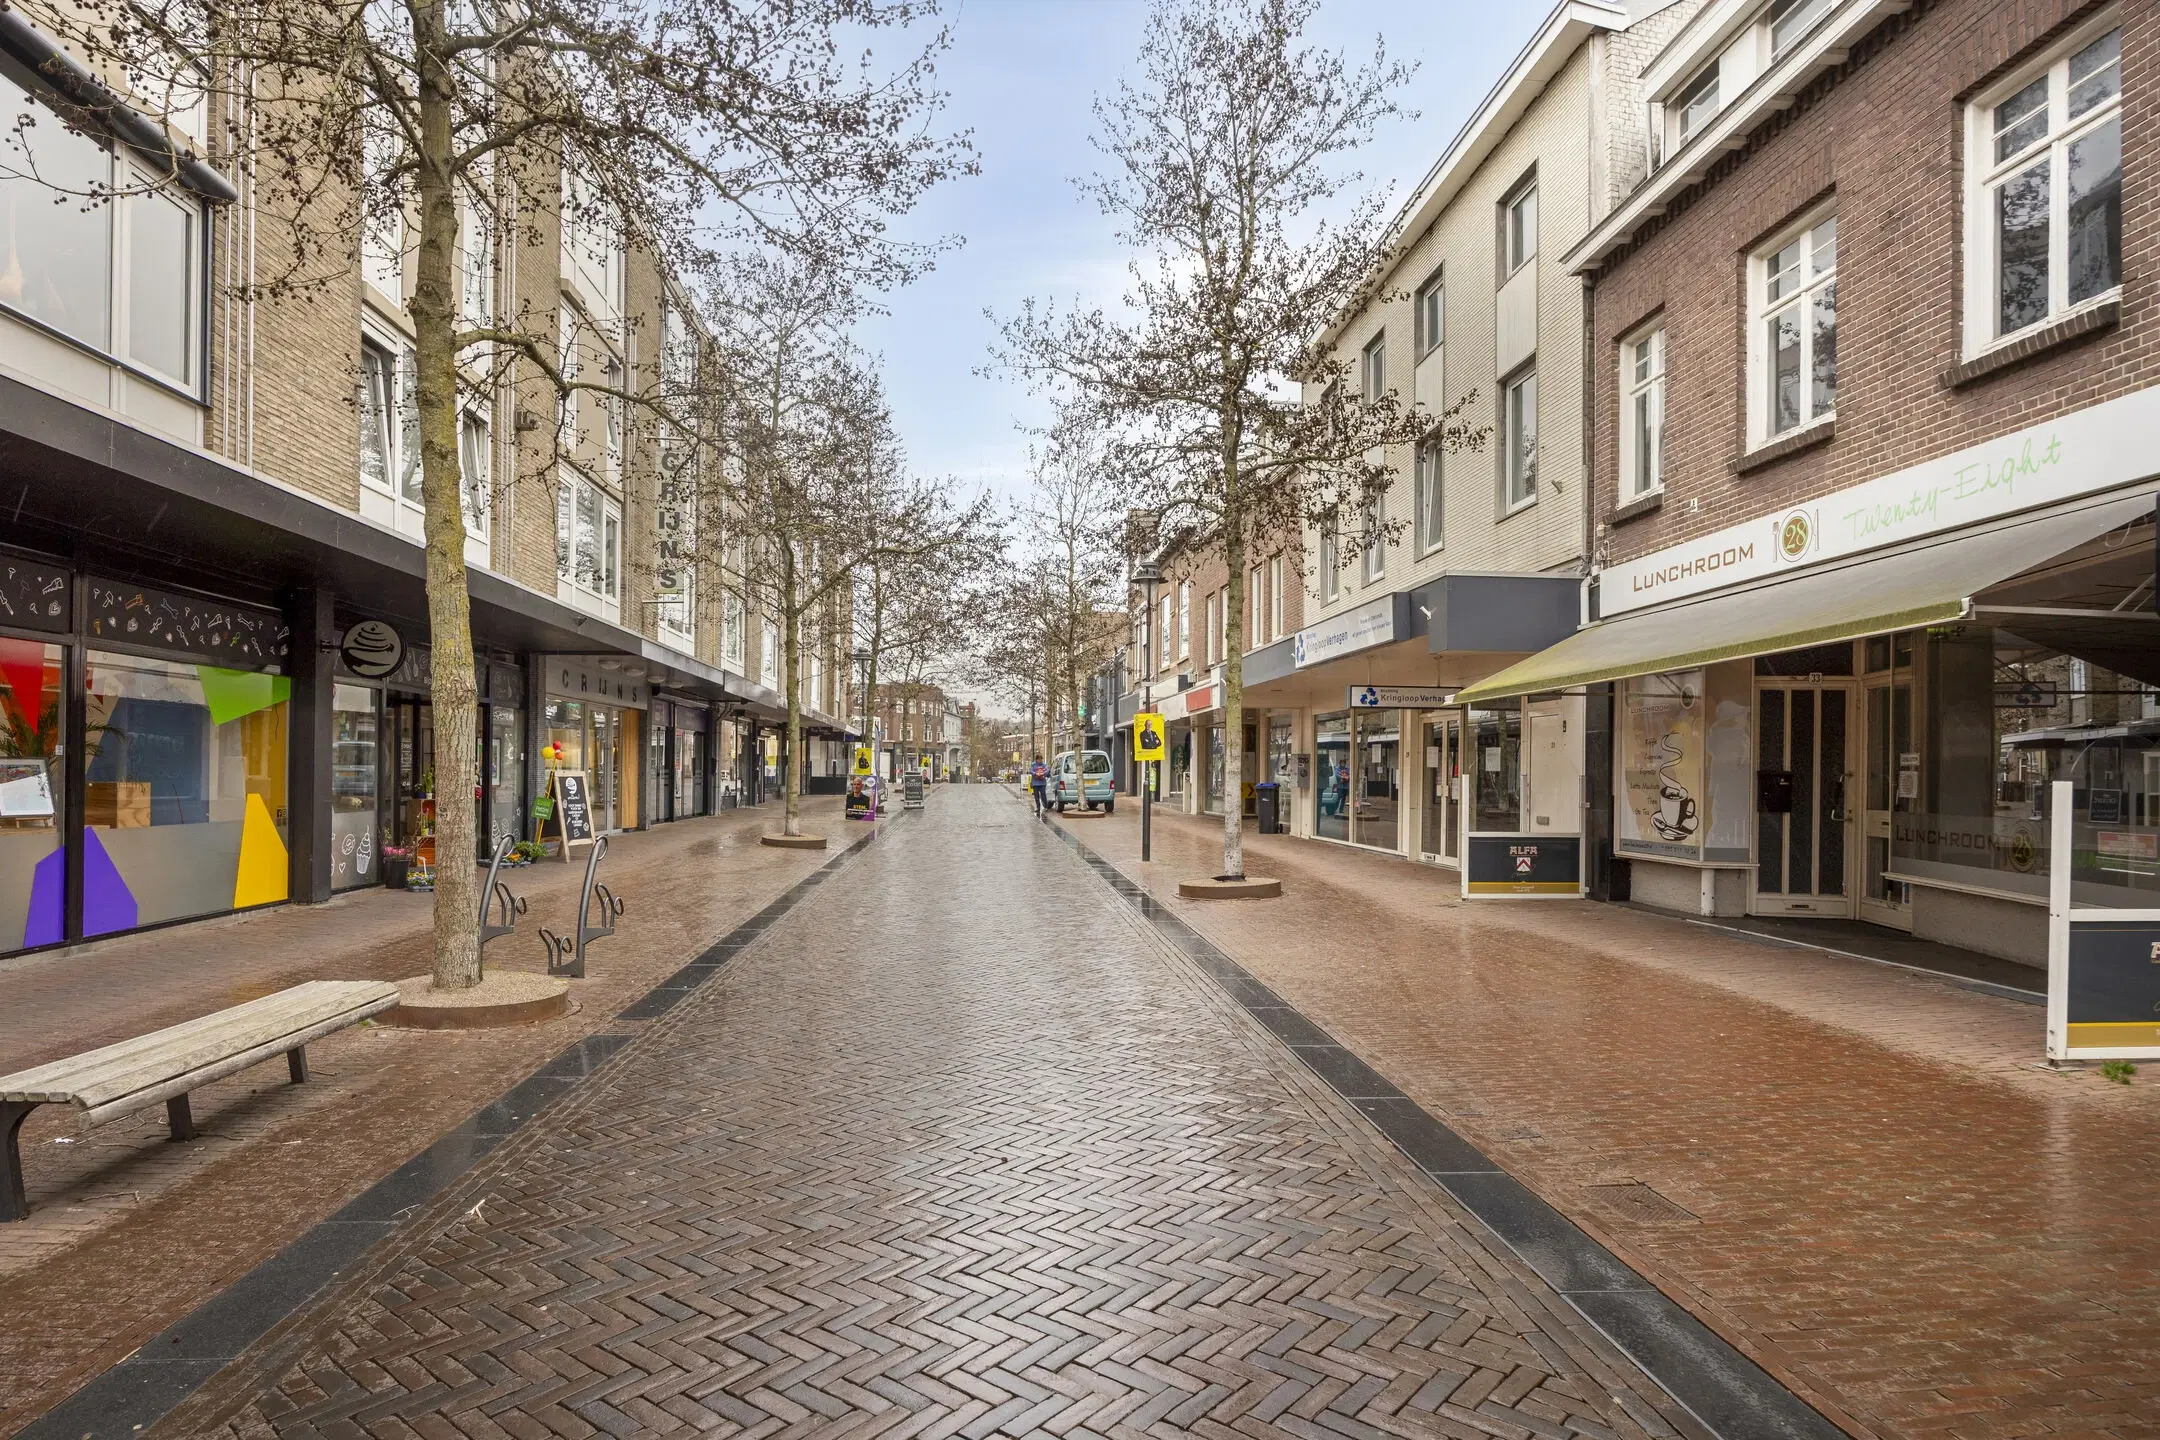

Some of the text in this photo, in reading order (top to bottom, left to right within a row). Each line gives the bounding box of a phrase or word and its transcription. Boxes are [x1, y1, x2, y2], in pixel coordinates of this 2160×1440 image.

[1843, 433, 2062, 544] Twenty-Eight
[1784, 520, 1808, 550] 28
[1633, 543, 1753, 592] LUNCHROOM
[1510, 846, 1538, 854] ALFA
